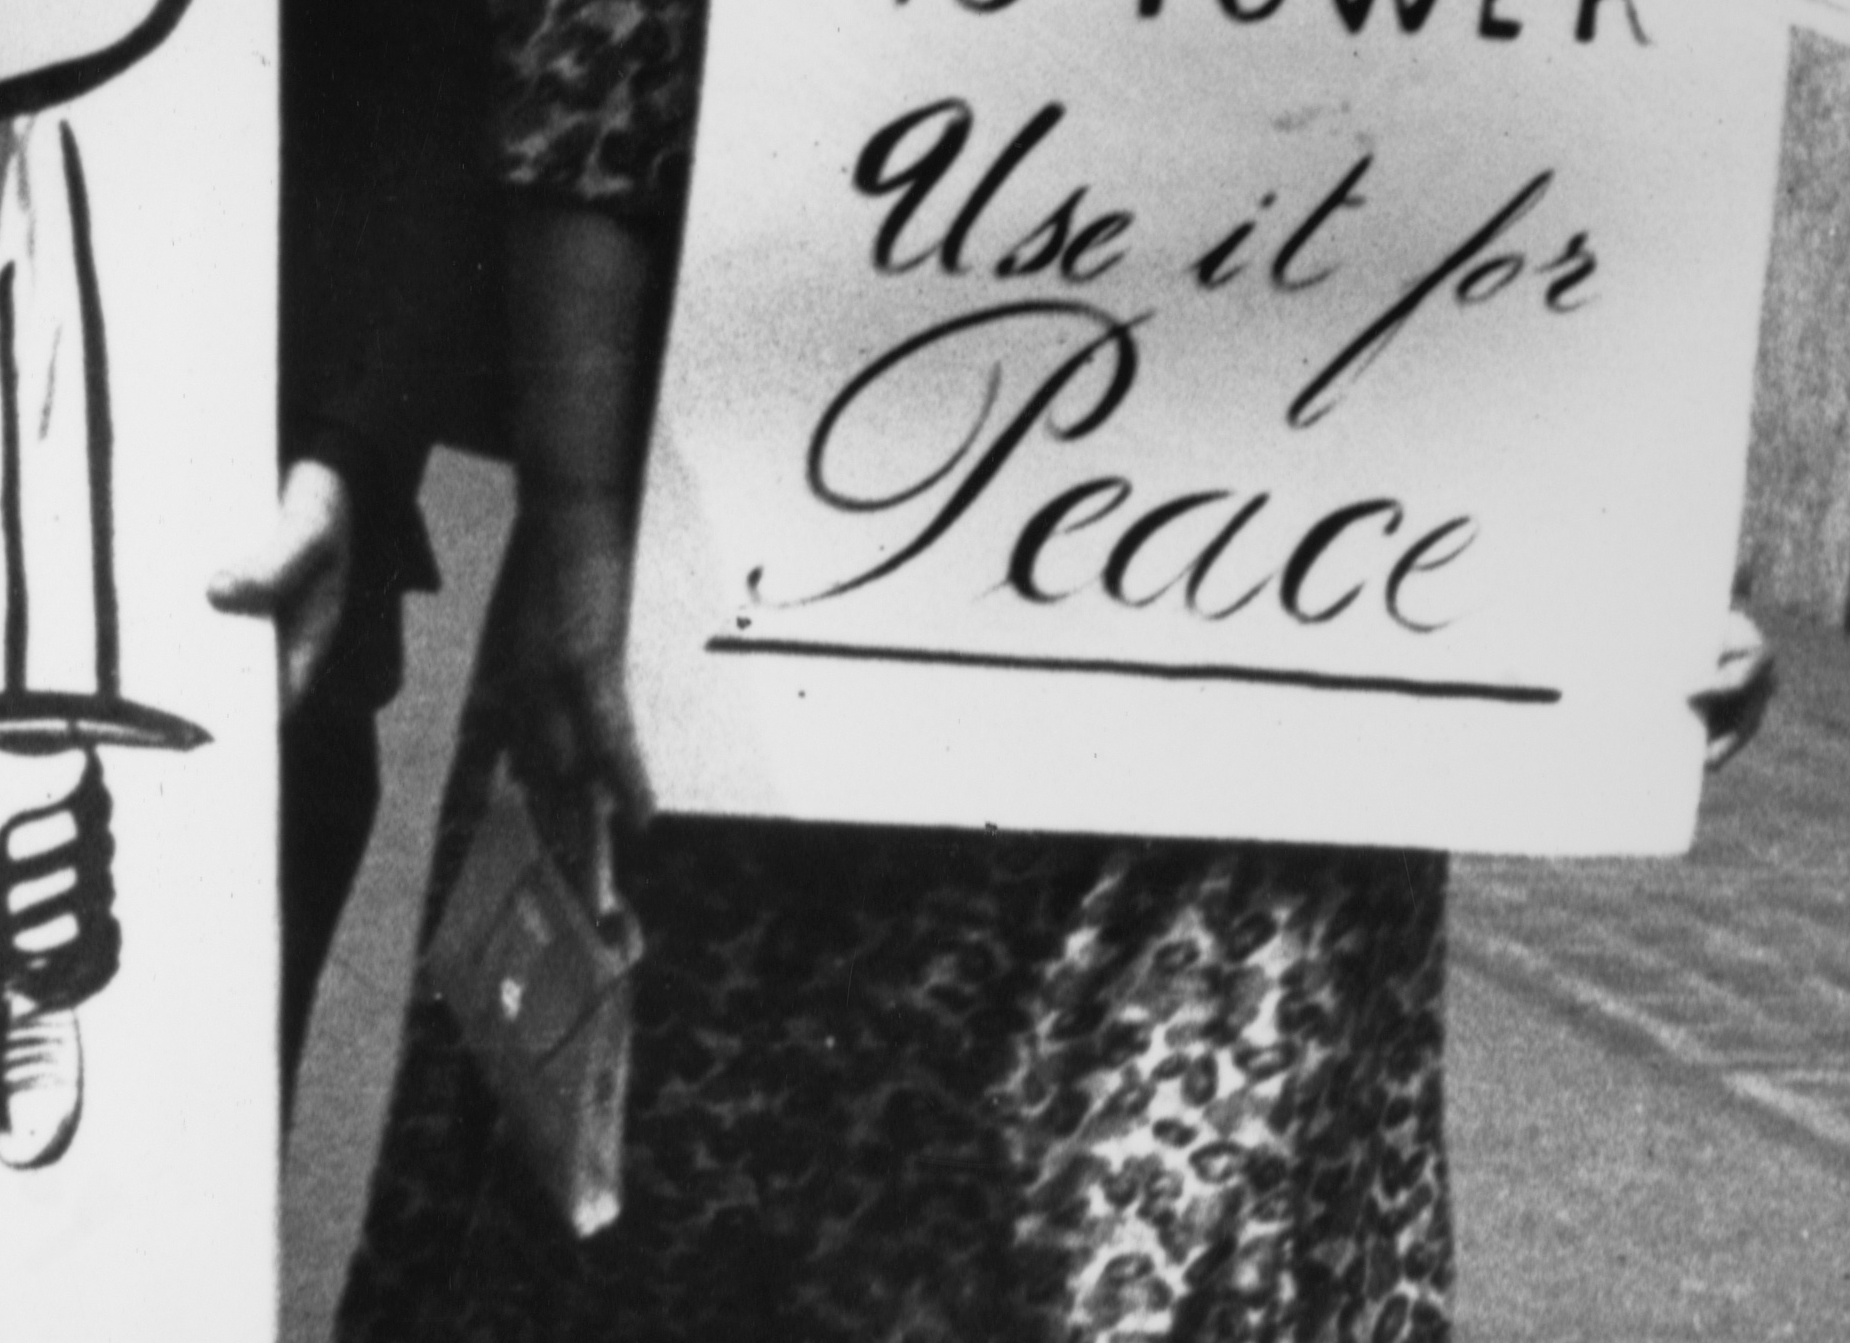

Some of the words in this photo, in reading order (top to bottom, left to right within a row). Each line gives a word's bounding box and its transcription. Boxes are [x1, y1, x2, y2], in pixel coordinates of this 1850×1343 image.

[851, 96, 1136, 284] Use
[1185, 154, 1375, 292] it
[1286, 169, 1603, 430] for
[746, 299, 1482, 632] Peace
